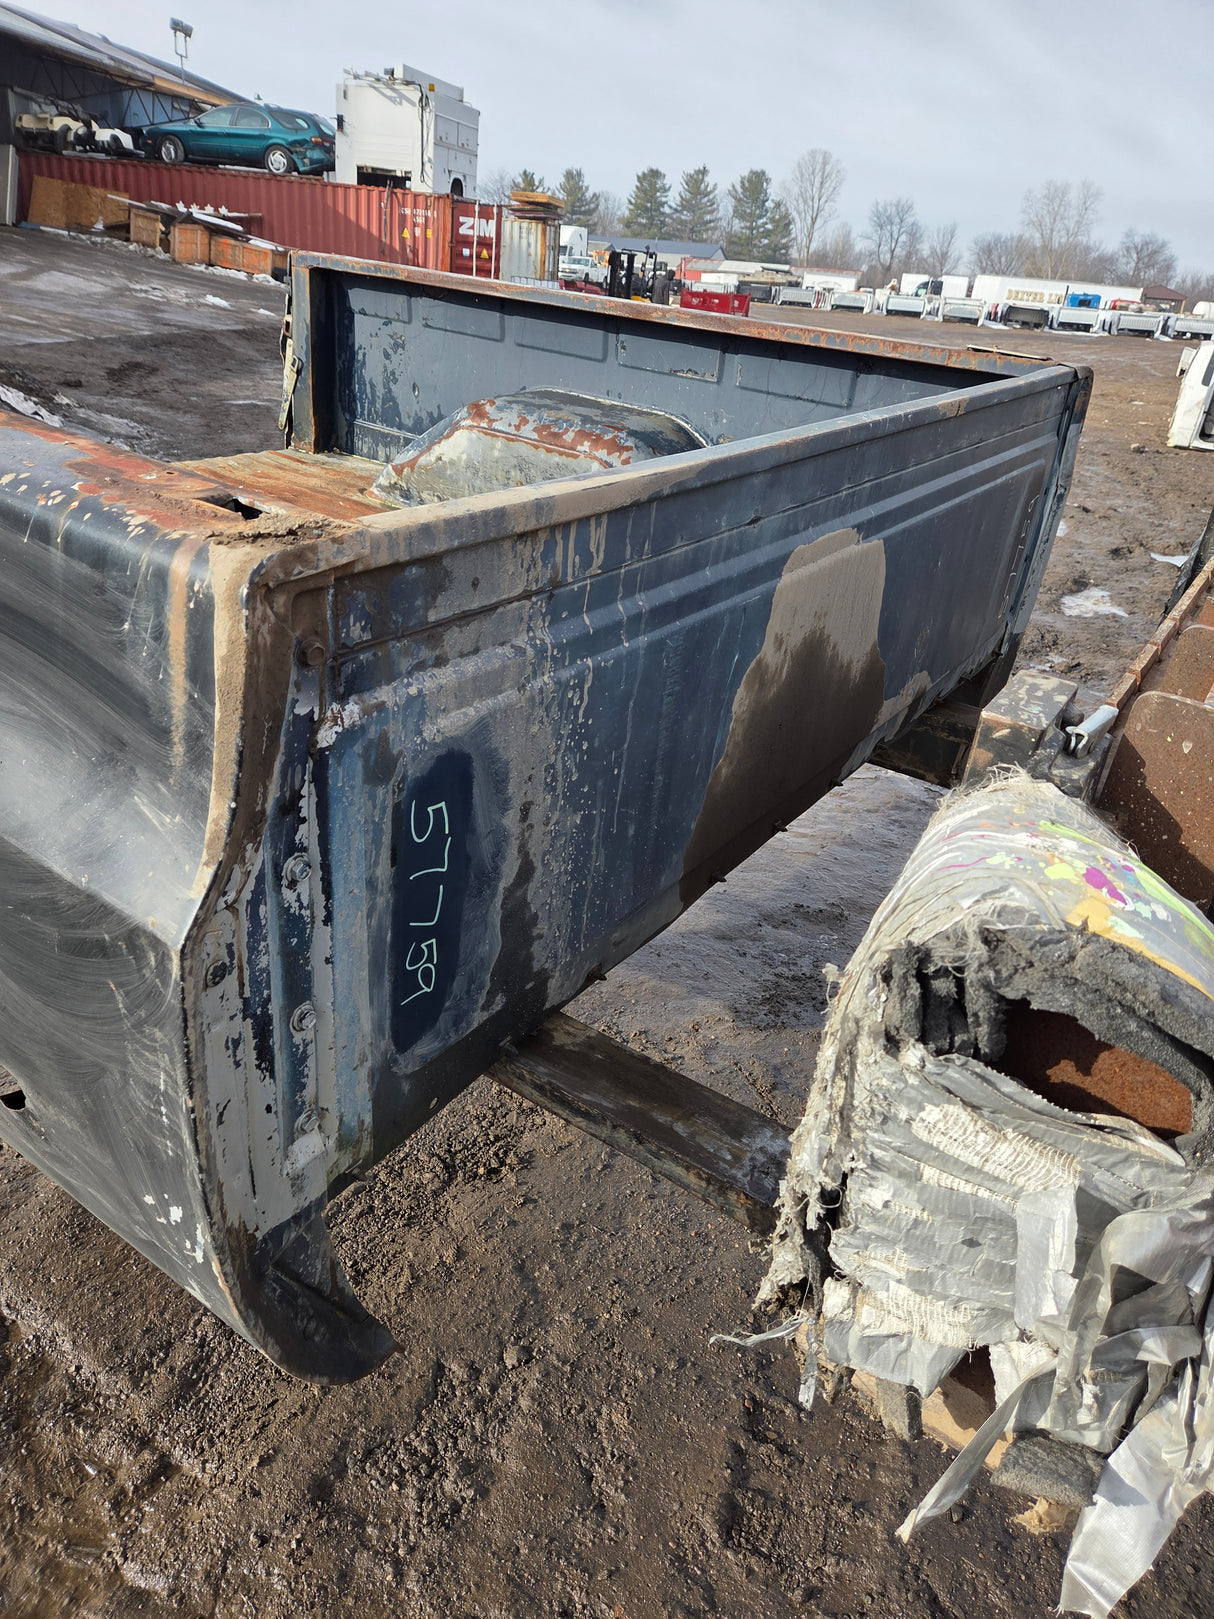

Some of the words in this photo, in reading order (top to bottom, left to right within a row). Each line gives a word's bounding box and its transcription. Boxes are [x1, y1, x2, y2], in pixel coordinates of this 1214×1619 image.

[458, 216, 496, 239] ZIM
[1006, 289, 1045, 304] DEXTER
[400, 799, 452, 1006] 57759
